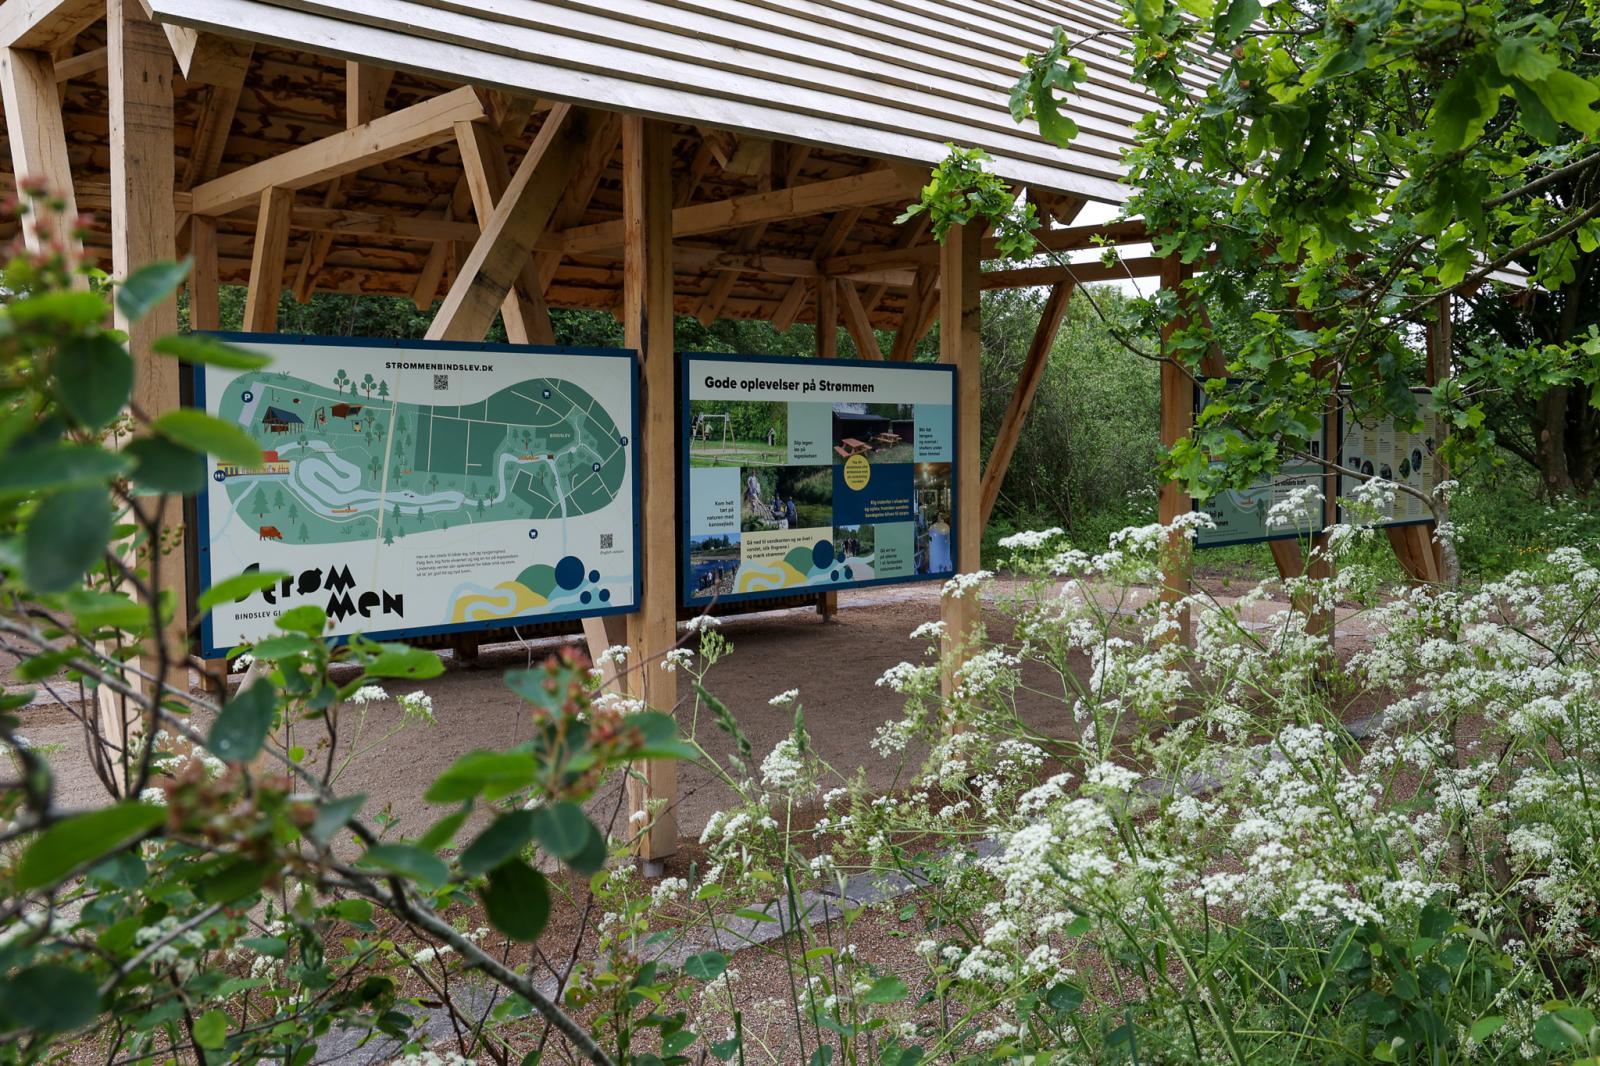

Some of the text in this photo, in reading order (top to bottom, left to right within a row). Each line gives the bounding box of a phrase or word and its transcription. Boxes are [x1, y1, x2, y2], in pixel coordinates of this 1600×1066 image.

[705, 376, 875, 393] Gode oplevelser på Strømmen
[235, 612, 270, 620] BINDSLEV
